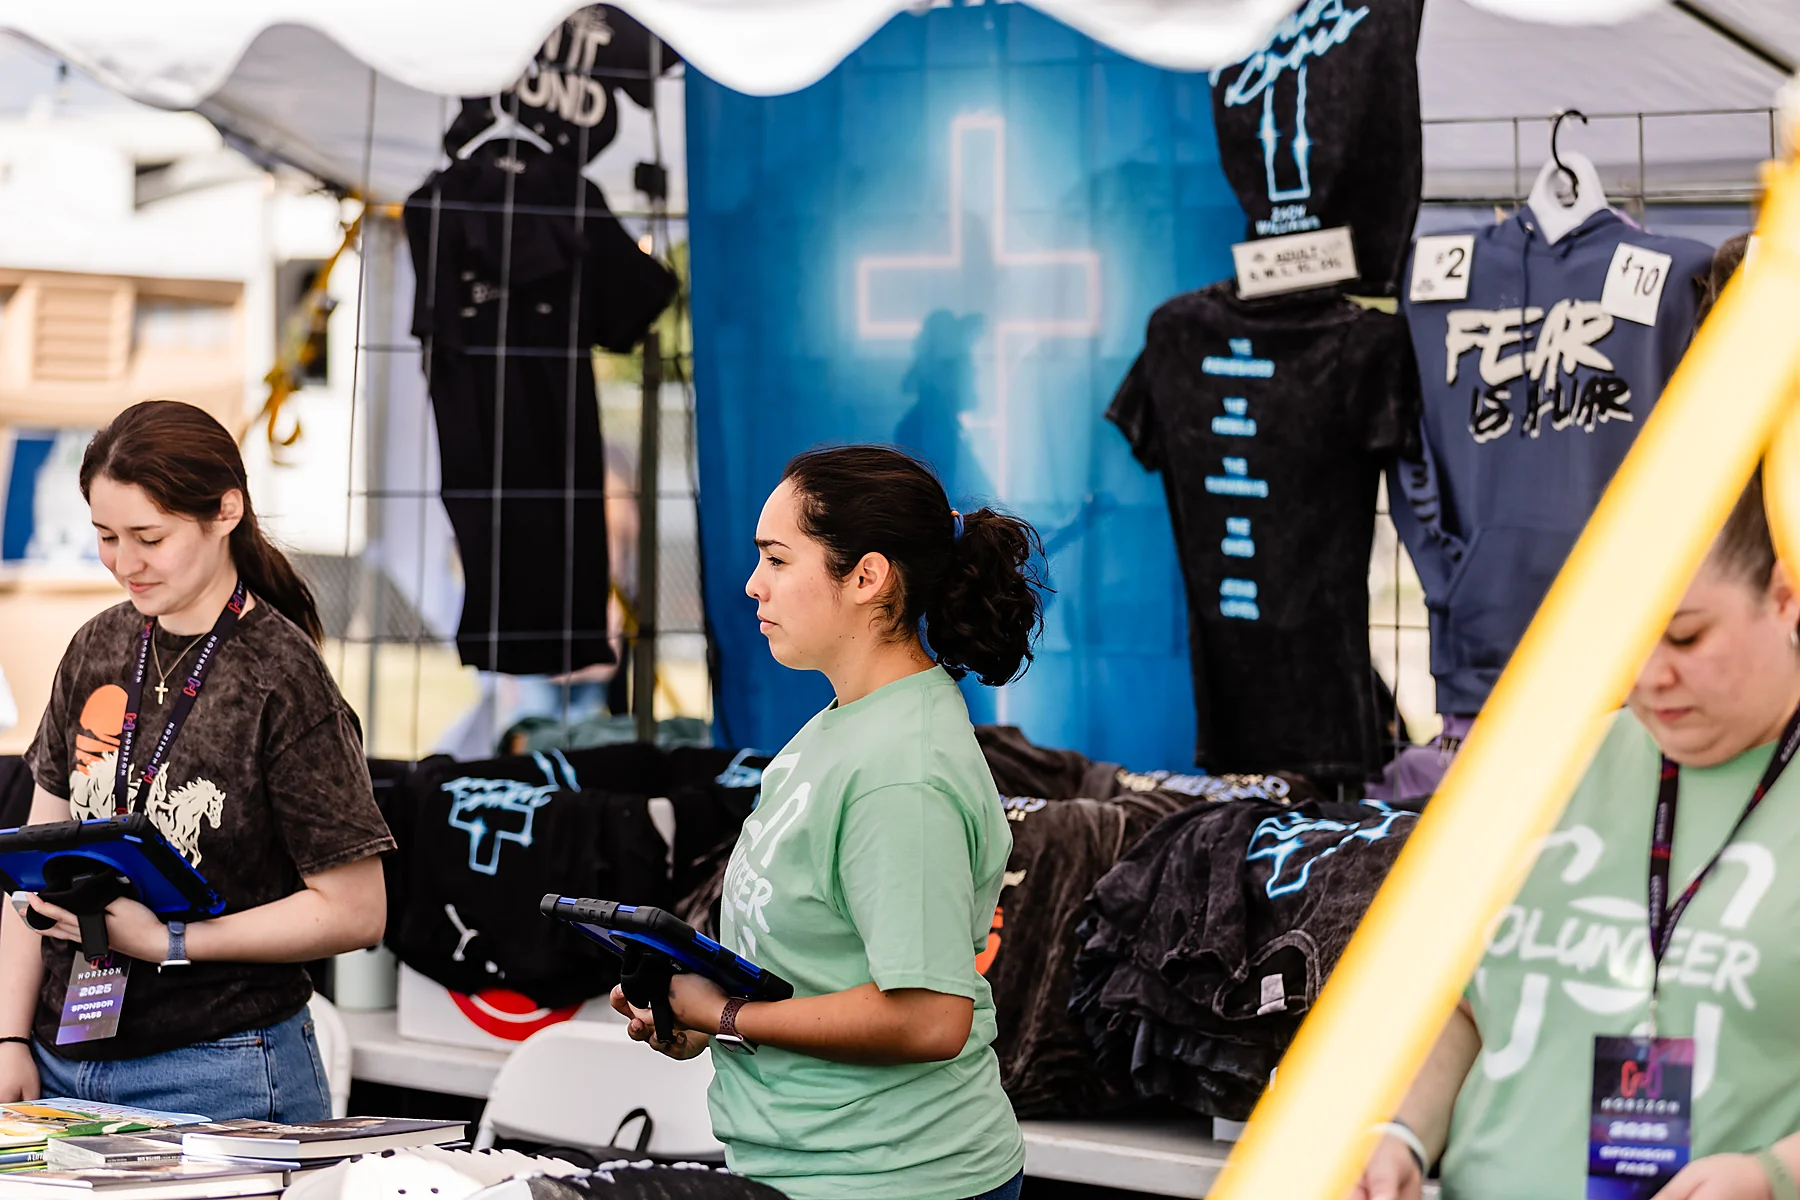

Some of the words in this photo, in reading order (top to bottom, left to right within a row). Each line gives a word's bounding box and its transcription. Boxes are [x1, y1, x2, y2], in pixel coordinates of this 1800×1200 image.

[1620, 253, 1660, 297] $70
[1446, 299, 1615, 391] FEAR
[1468, 384, 1514, 443] IS
[192, 634, 217, 677] HORIZON
[121, 731, 132, 776] HORIZON
[151, 721, 175, 764] HORIZON
[77, 966, 122, 981] HORIZON
[79, 983, 113, 998] 2025
[71, 999, 115, 1013] SPONSOR
[78, 1010, 103, 1021] PASS
